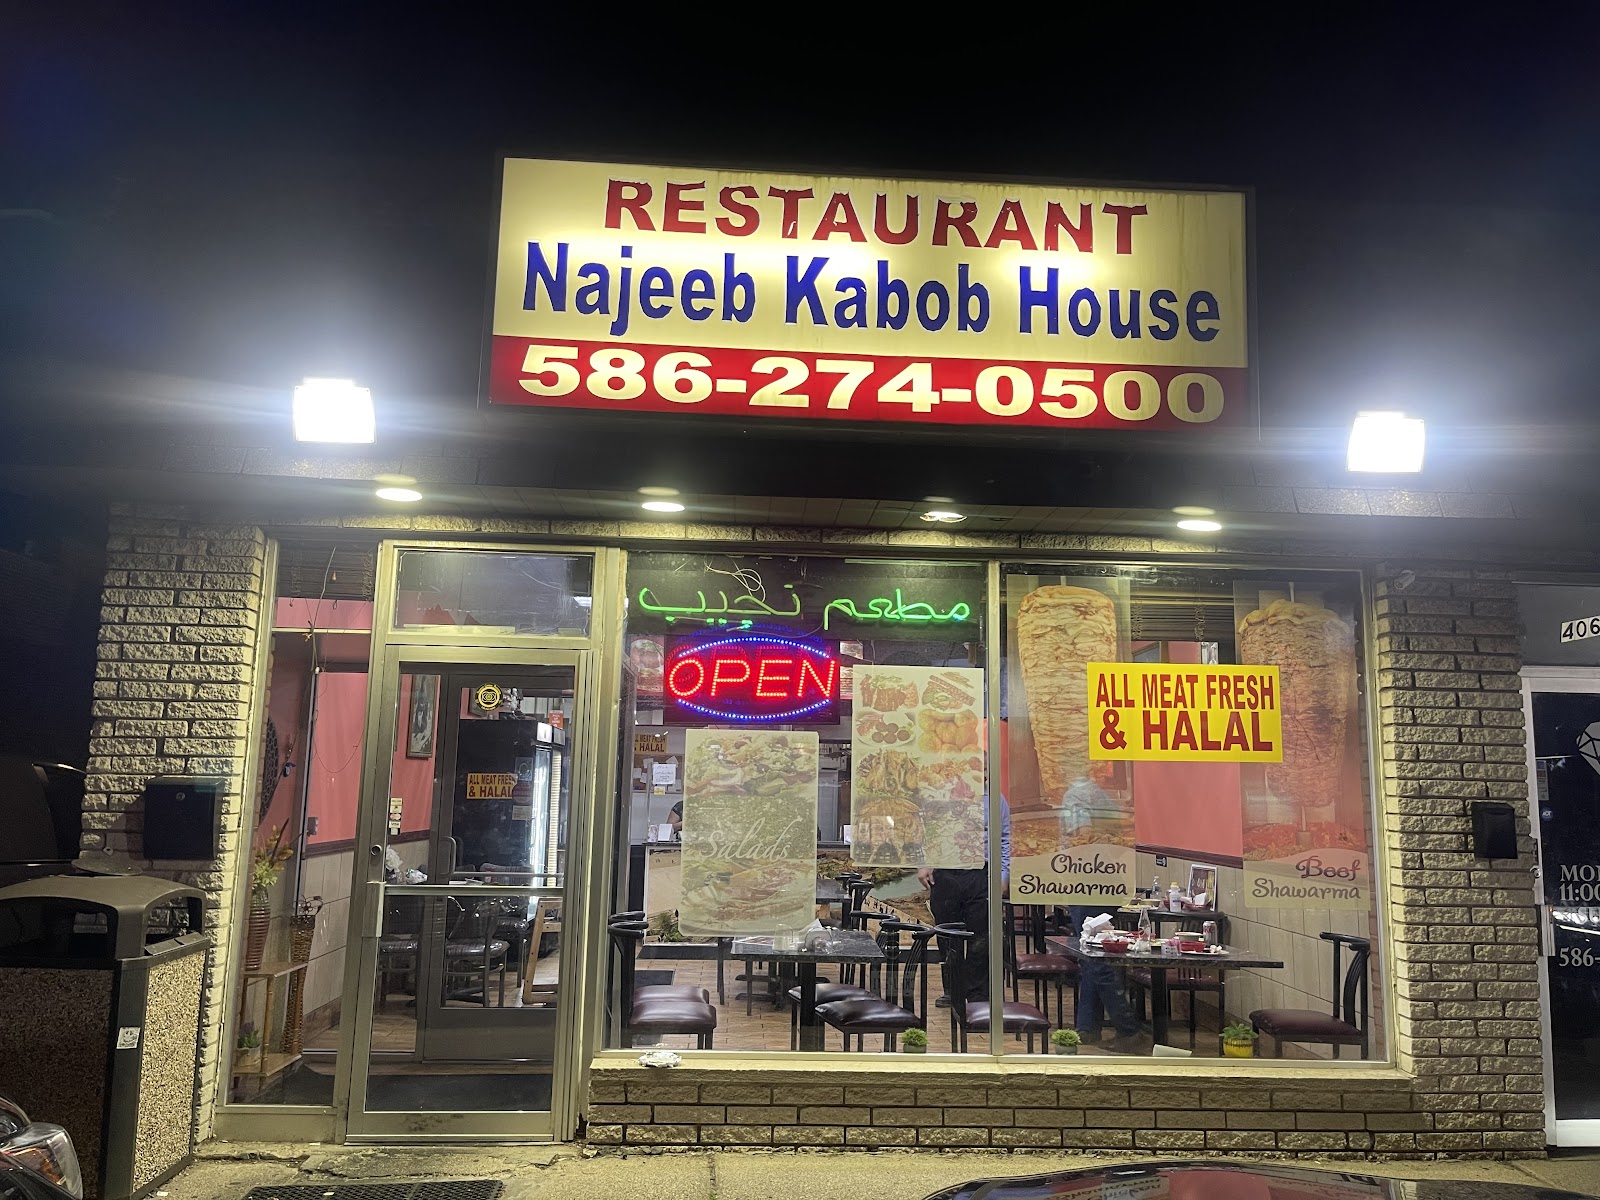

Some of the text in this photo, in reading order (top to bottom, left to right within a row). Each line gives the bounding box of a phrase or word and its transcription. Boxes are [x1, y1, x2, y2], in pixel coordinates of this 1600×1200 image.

[603, 177, 1149, 255] RESTAURANT
[522, 241, 1221, 342] Najeeb Kabob House
[518, 345, 1226, 424] 586-274-0500
[824, 588, 971, 631] مطعم
[668, 658, 836, 698] OPEN
[1095, 673, 1275, 710] ALL MEAT FRESH
[640, 742, 665, 752] HALAL
[1099, 708, 1274, 752] & HALAL
[468, 774, 480, 785] ALL
[480, 774, 497, 785] MEAT
[468, 785, 476, 798] &
[479, 785, 513, 798] HALAL
[700, 816, 803, 862] Salads
[1050, 853, 1127, 875] Chicken
[1295, 855, 1361, 881] Beef
[1018, 873, 1128, 898] Shawarma
[1251, 877, 1361, 901] Shawarma
